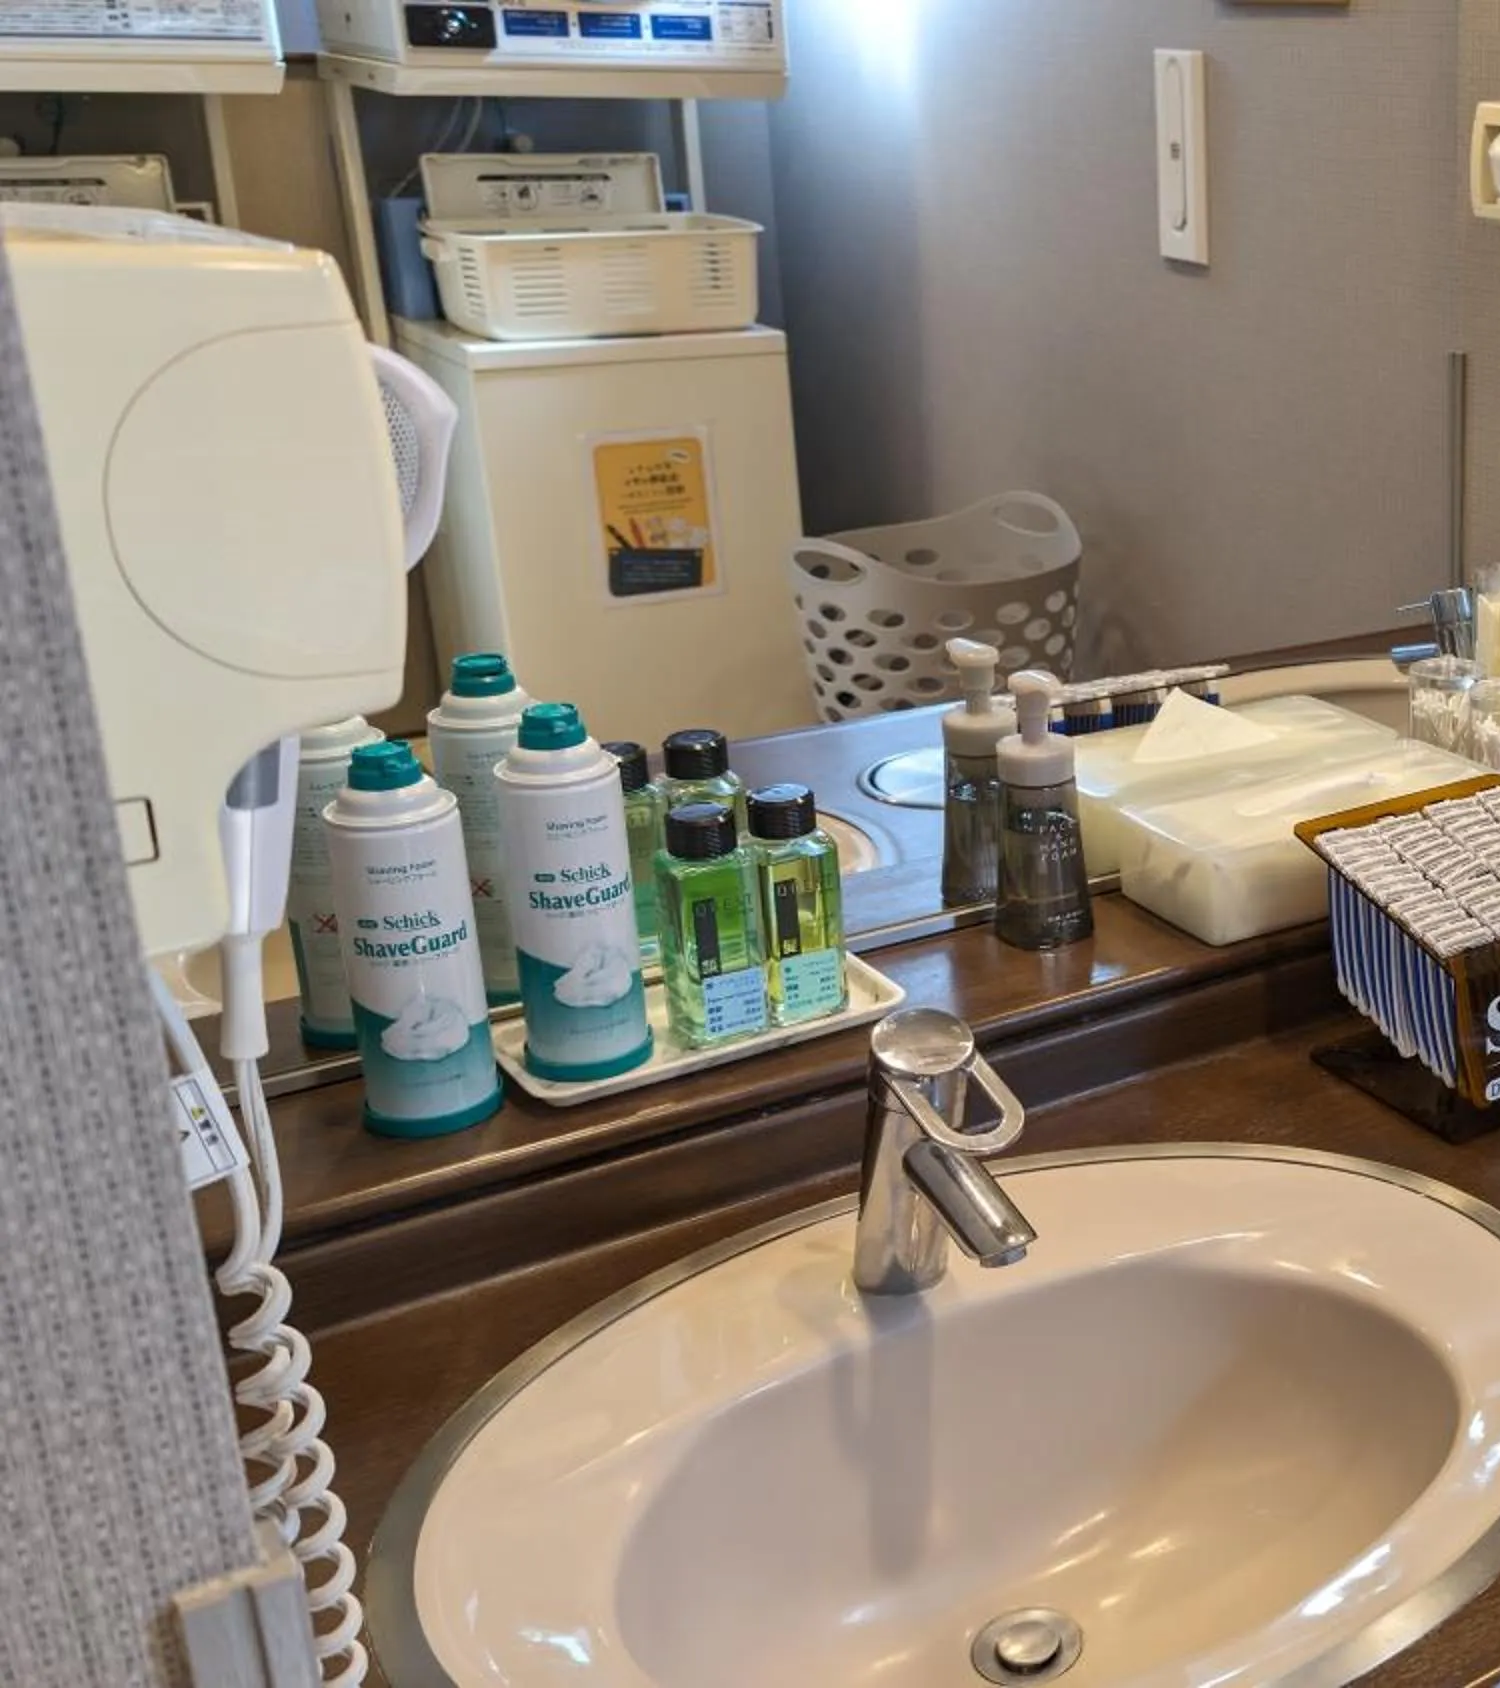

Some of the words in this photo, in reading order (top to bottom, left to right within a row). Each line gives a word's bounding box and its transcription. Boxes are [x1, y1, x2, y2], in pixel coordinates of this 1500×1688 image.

[560, 862, 612, 884] Schick
[383, 911, 442, 932] Schick
[352, 918, 469, 959] ShaveGuard
